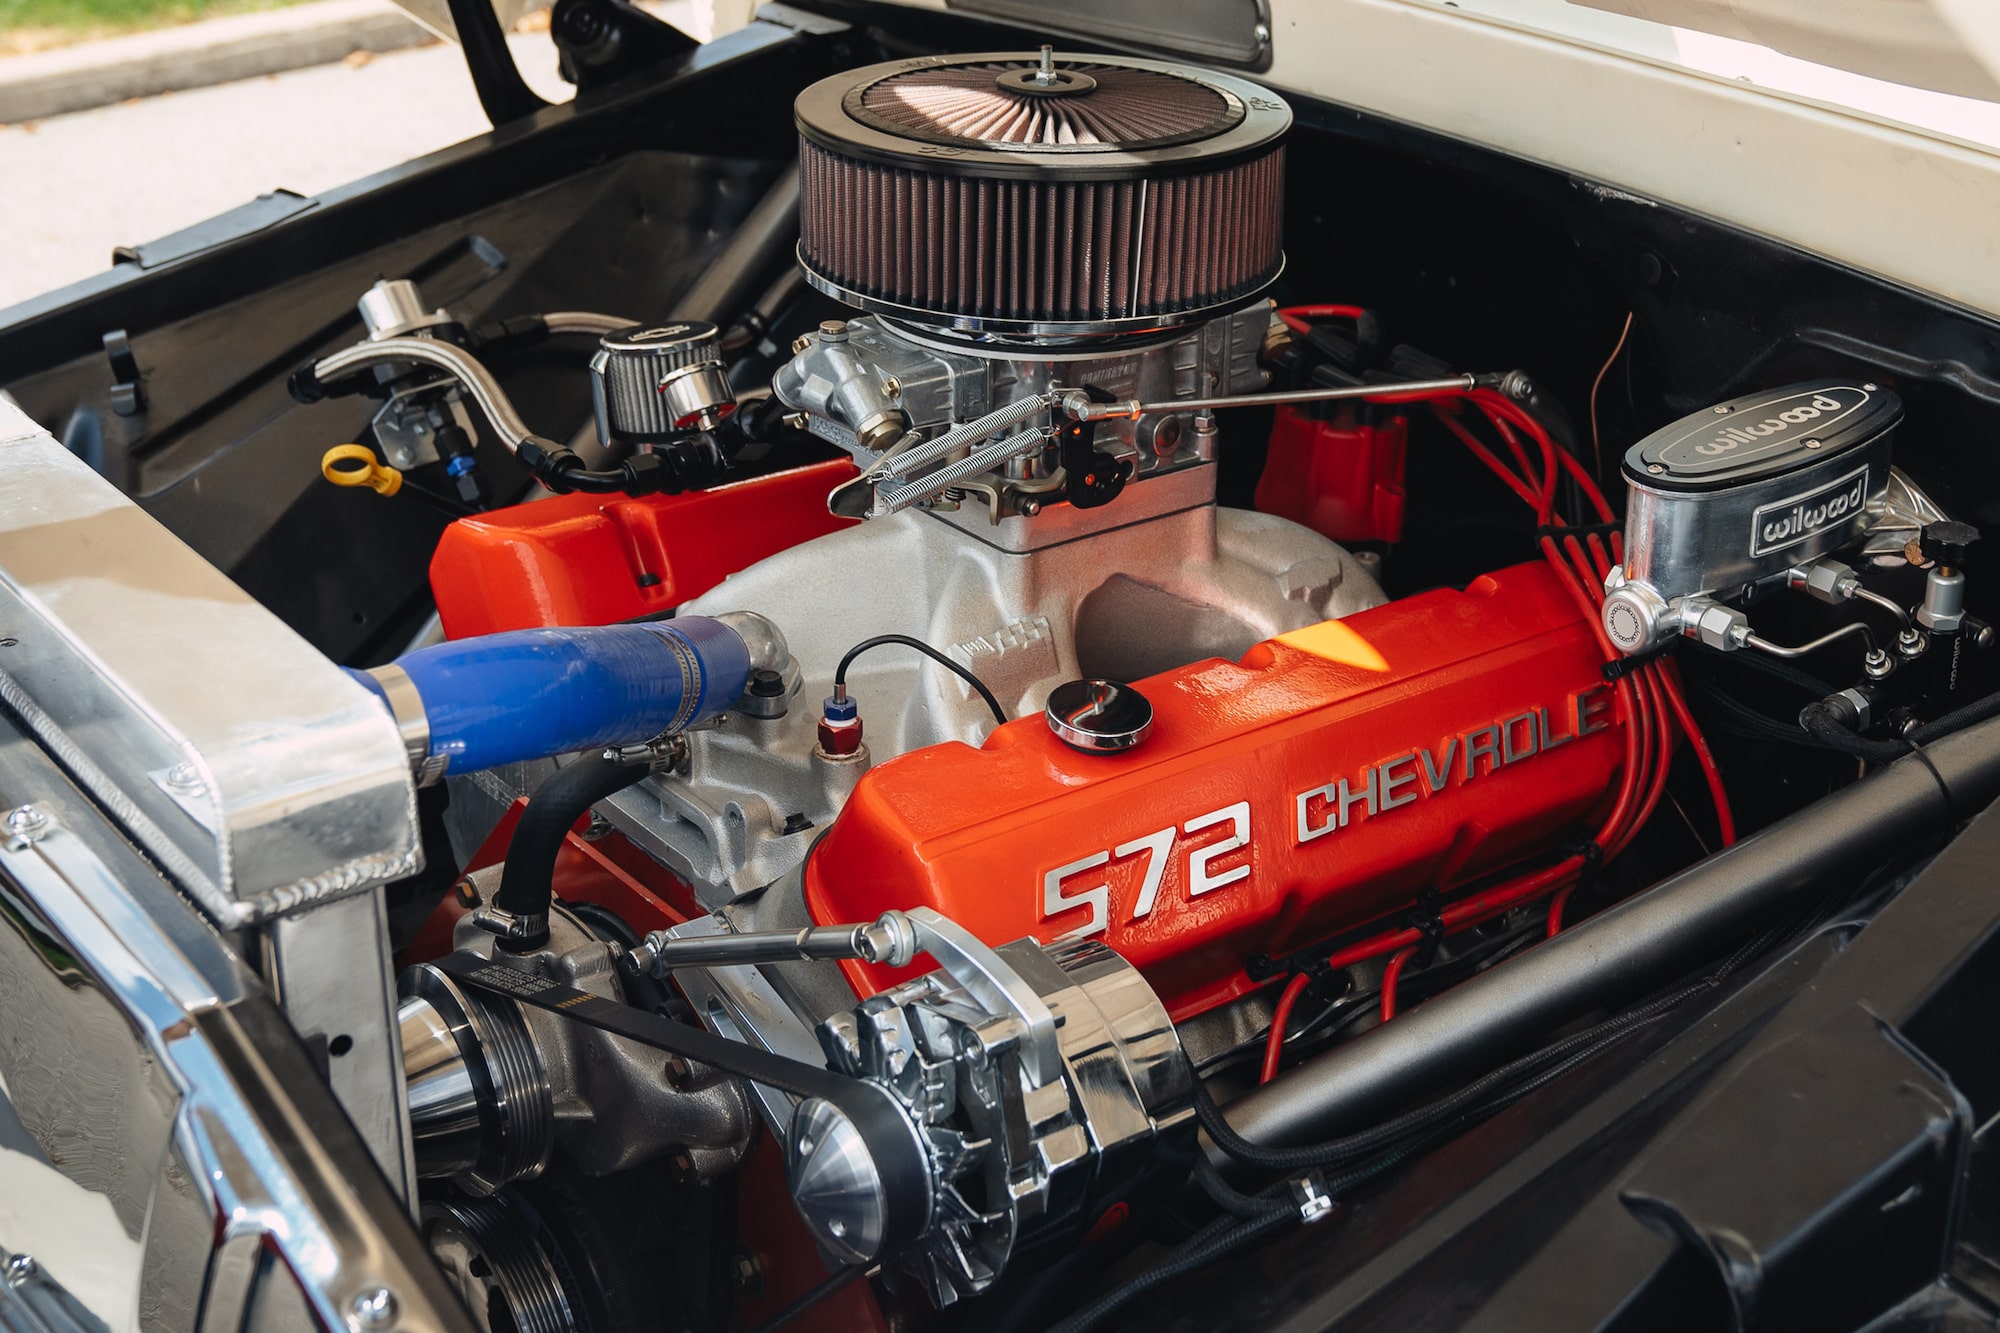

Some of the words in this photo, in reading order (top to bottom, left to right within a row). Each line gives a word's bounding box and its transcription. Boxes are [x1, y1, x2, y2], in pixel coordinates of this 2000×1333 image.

[1695, 395, 1842, 455] wilwood
[1763, 479, 1862, 542] wilwood
[1044, 801, 1250, 938] 572
[1297, 683, 1609, 842] CHEVROLE
